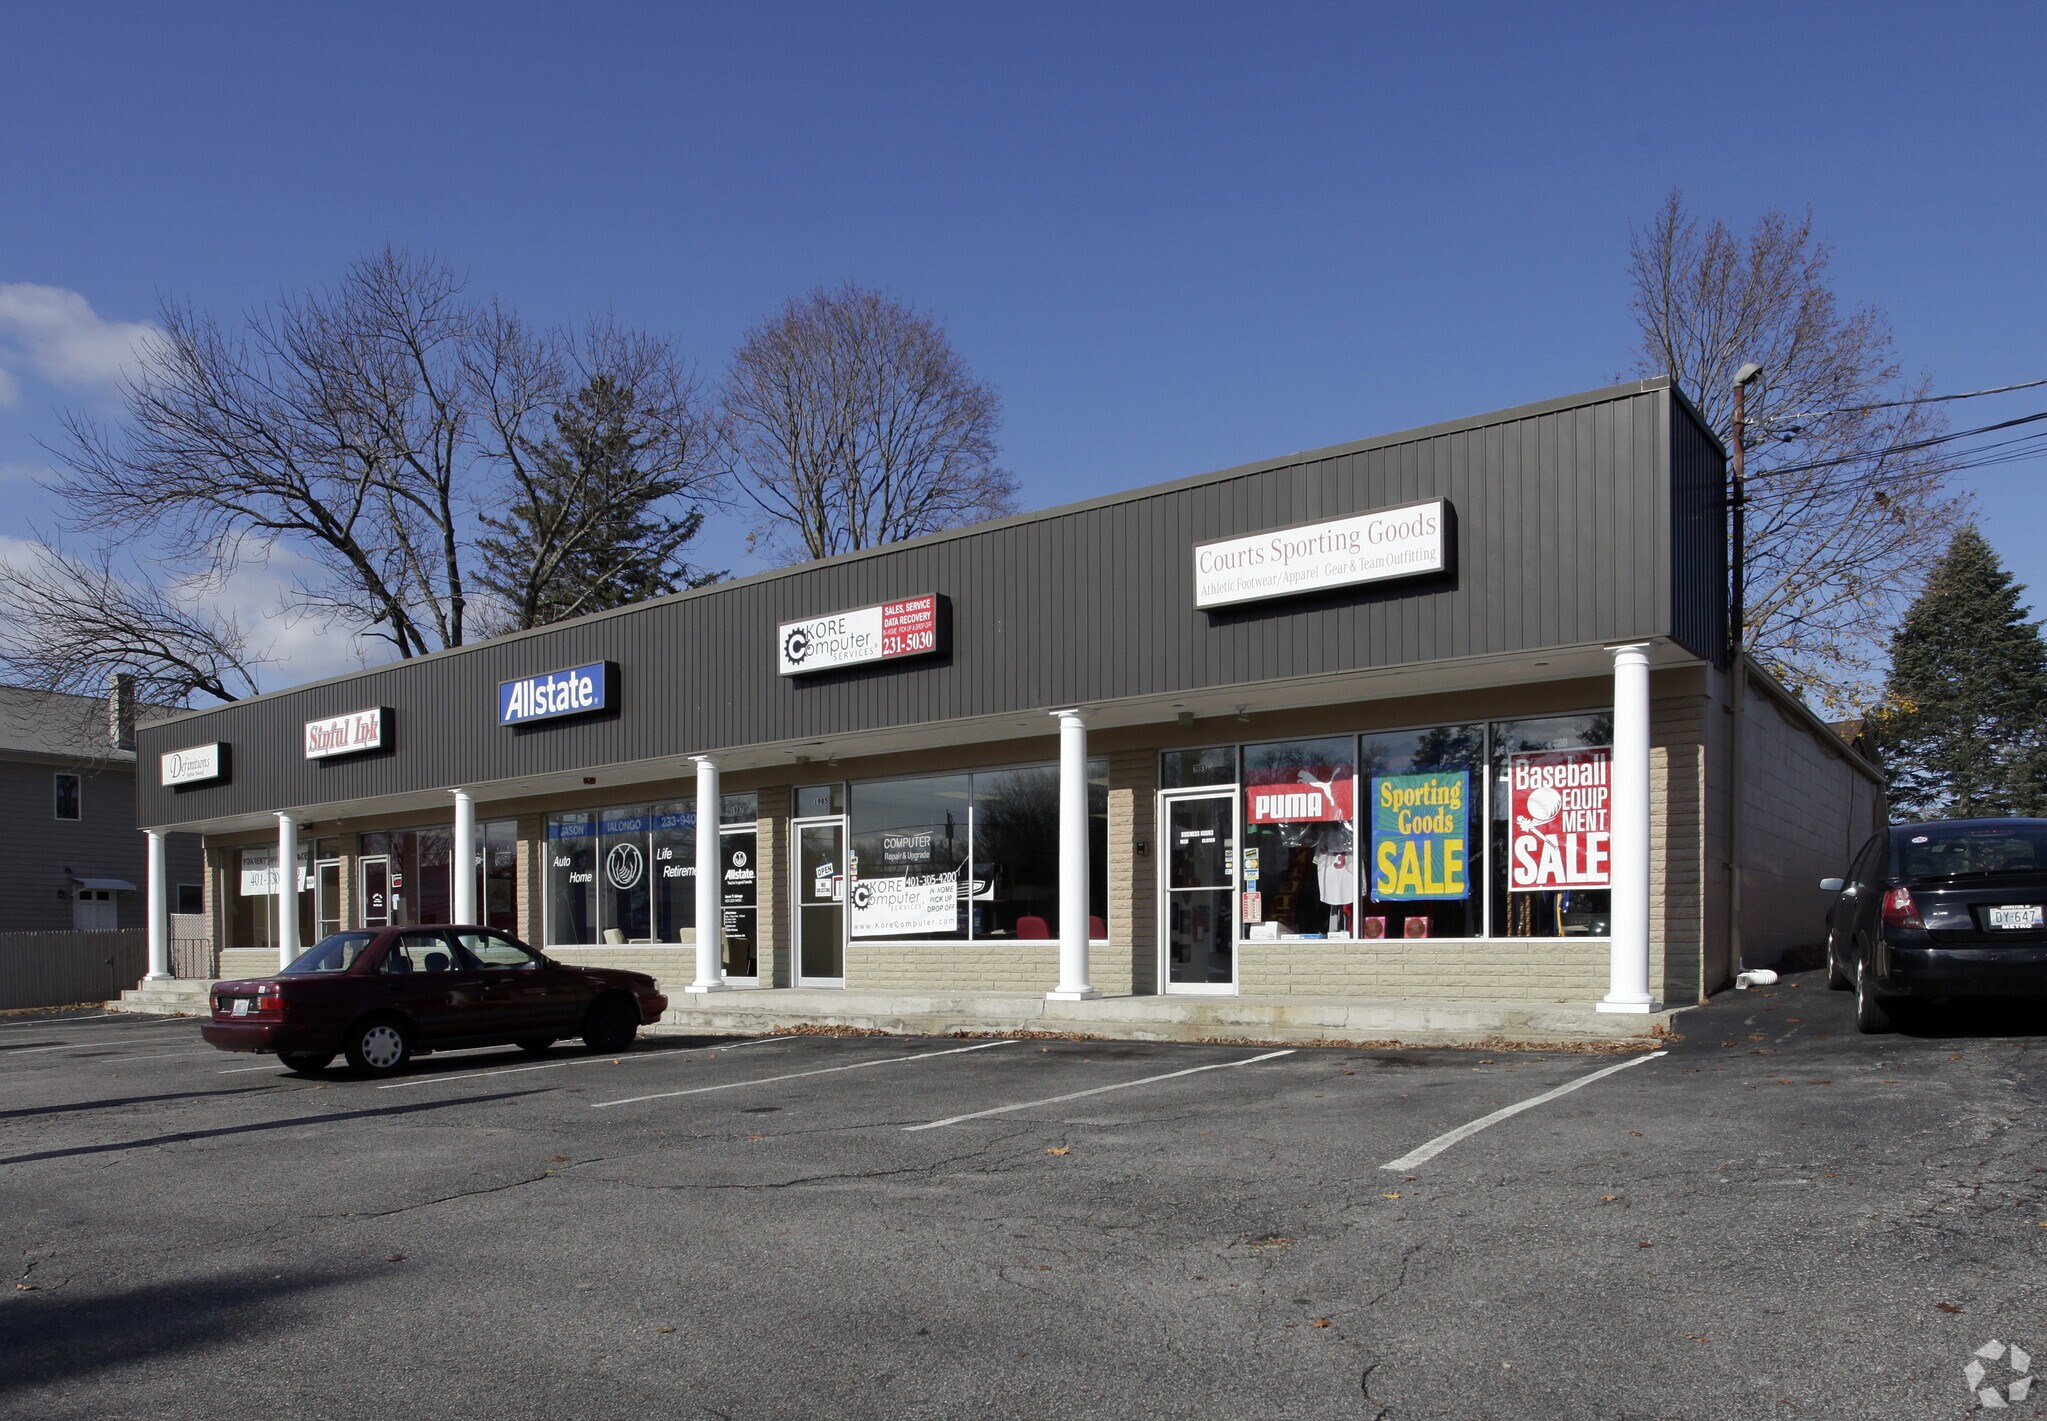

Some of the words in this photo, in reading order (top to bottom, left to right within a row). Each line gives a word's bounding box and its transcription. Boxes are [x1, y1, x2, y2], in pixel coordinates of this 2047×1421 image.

[1200, 545, 1264, 573] Courts
[1271, 529, 1361, 566] Sporting
[1368, 513, 1436, 544] Goods
[1201, 580, 1235, 596] Athletic
[1237, 565, 1318, 590] Footwear/Apparel
[1324, 562, 1348, 576] Gear
[1350, 559, 1357, 572] &
[1359, 556, 1384, 571] Team
[1386, 548, 1436, 566] Outfitting
[885, 604, 905, 616] SALES,
[906, 599, 931, 612] SERVICE
[885, 617, 898, 627] DATA
[900, 611, 931, 624] RECOVERY
[806, 618, 847, 640] KORE
[883, 631, 933, 655] 231-5030
[833, 649, 874, 661] SERVICES
[505, 670, 593, 720] Allstate
[308, 719, 350, 753] Sinful
[354, 714, 379, 747] Ink
[170, 754, 210, 778] Definitions
[1516, 753, 1606, 790] Baseball
[1380, 779, 1462, 812] Sporting
[1562, 787, 1608, 810] EQUIP
[1256, 793, 1322, 819] PUMA
[560, 825, 584, 836] JASON
[607, 819, 641, 832] IALONGO
[661, 814, 697, 827] 233-940
[1399, 807, 1454, 834] Goods
[1562, 809, 1608, 832] MENT
[884, 836, 930, 849] COMPUTER
[553, 856, 571, 867] Auto
[657, 848, 673, 860] Life
[884, 852, 902, 861] Repair
[907, 851, 930, 861] Upgrade
[1333, 852, 1346, 869] 3
[1514, 832, 1609, 884] SALE
[663, 865, 697, 878] Retireme
[725, 869, 754, 880] Allstate
[817, 863, 832, 876] OPEN
[1378, 839, 1465, 895] SALE
[569, 872, 592, 883] Home
[906, 872, 957, 887] 401-305-4200
[869, 880, 903, 893] KORE
[929, 886, 954, 894] IN-HOME
[890, 903, 921, 911] SERVICES
[854, 918, 955, 930] www.KoreComputer.com
